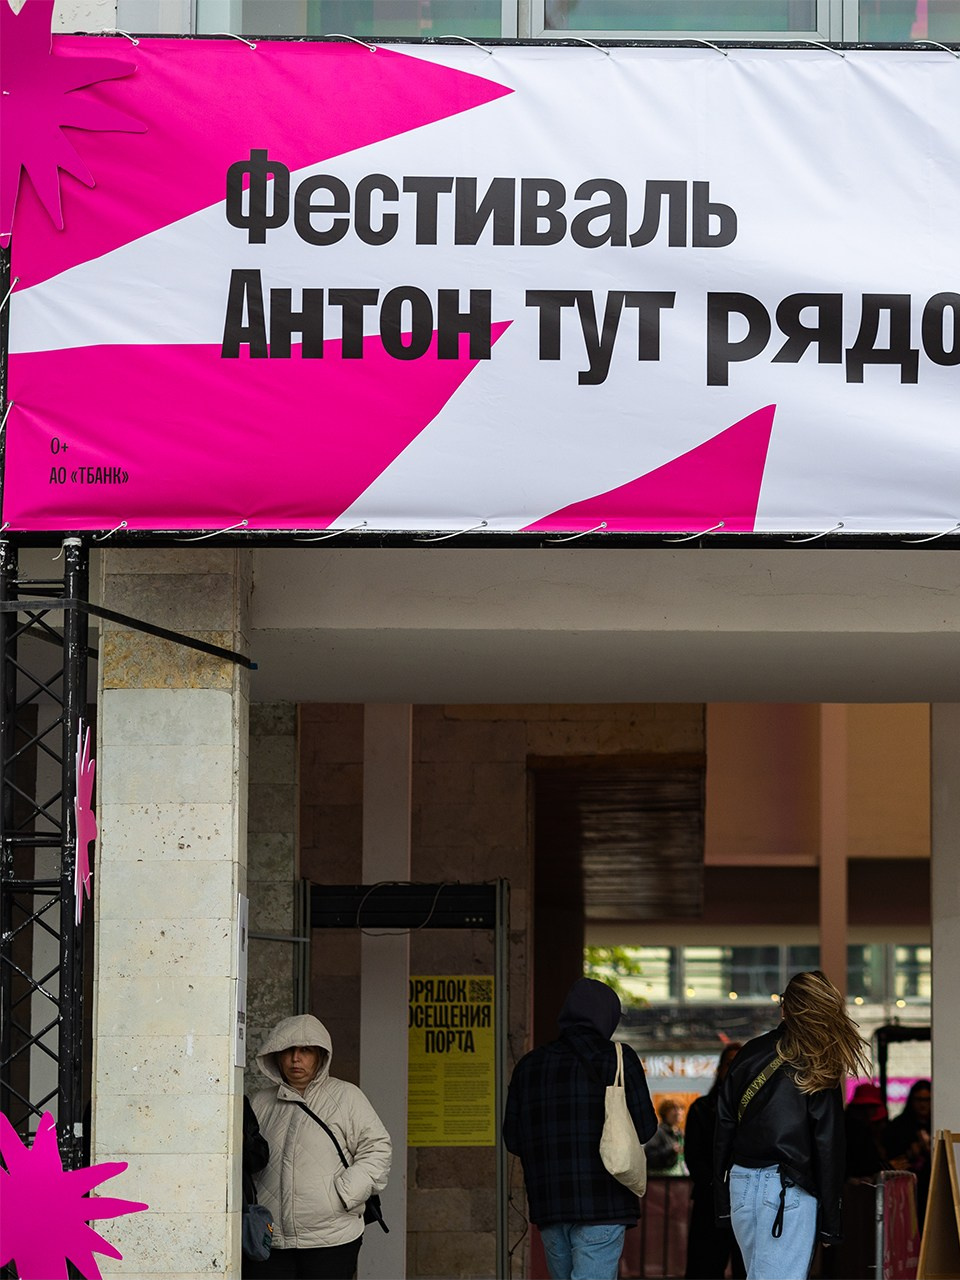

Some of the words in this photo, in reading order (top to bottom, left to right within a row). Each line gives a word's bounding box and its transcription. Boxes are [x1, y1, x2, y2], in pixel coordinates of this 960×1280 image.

[226, 149, 737, 249] Фестиваль
[222, 268, 492, 361] Антон
[525, 289, 676, 386] тут
[49, 466, 67, 485] АО
[70, 466, 129, 485] «ТБАНК»
[408, 979, 468, 1003] ОРЯДОК
[408, 1004, 492, 1030] ОСЕЩЕНИЯ
[425, 1030, 476, 1054] ПОРТА
